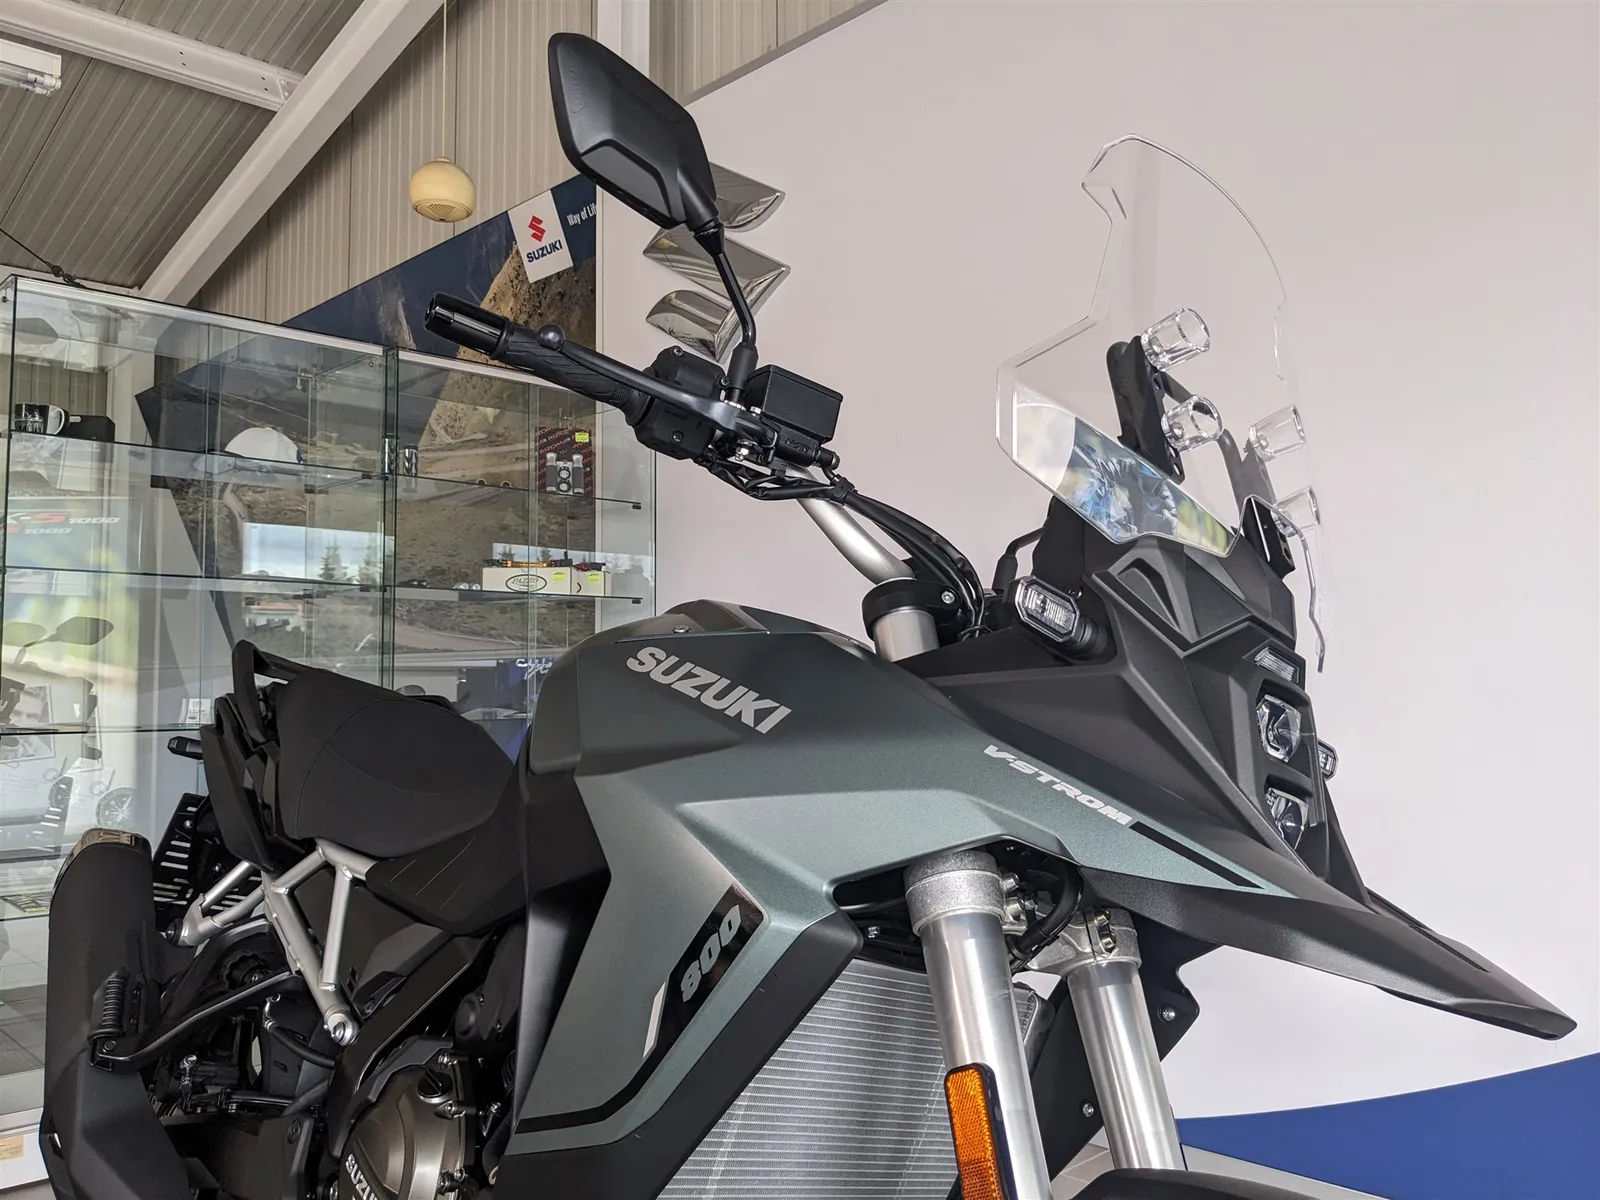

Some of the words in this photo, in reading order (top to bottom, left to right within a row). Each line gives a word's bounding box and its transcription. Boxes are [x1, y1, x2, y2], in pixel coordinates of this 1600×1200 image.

[566, 212, 581, 226] Way
[580, 206, 588, 220] of
[586, 202, 597, 217] Lif
[526, 239, 563, 263] SUZUKI
[626, 646, 792, 734] SUZUKI
[983, 744, 1133, 826] V-STROM
[680, 904, 742, 1003] 800
[345, 1153, 379, 1200] SUZU
